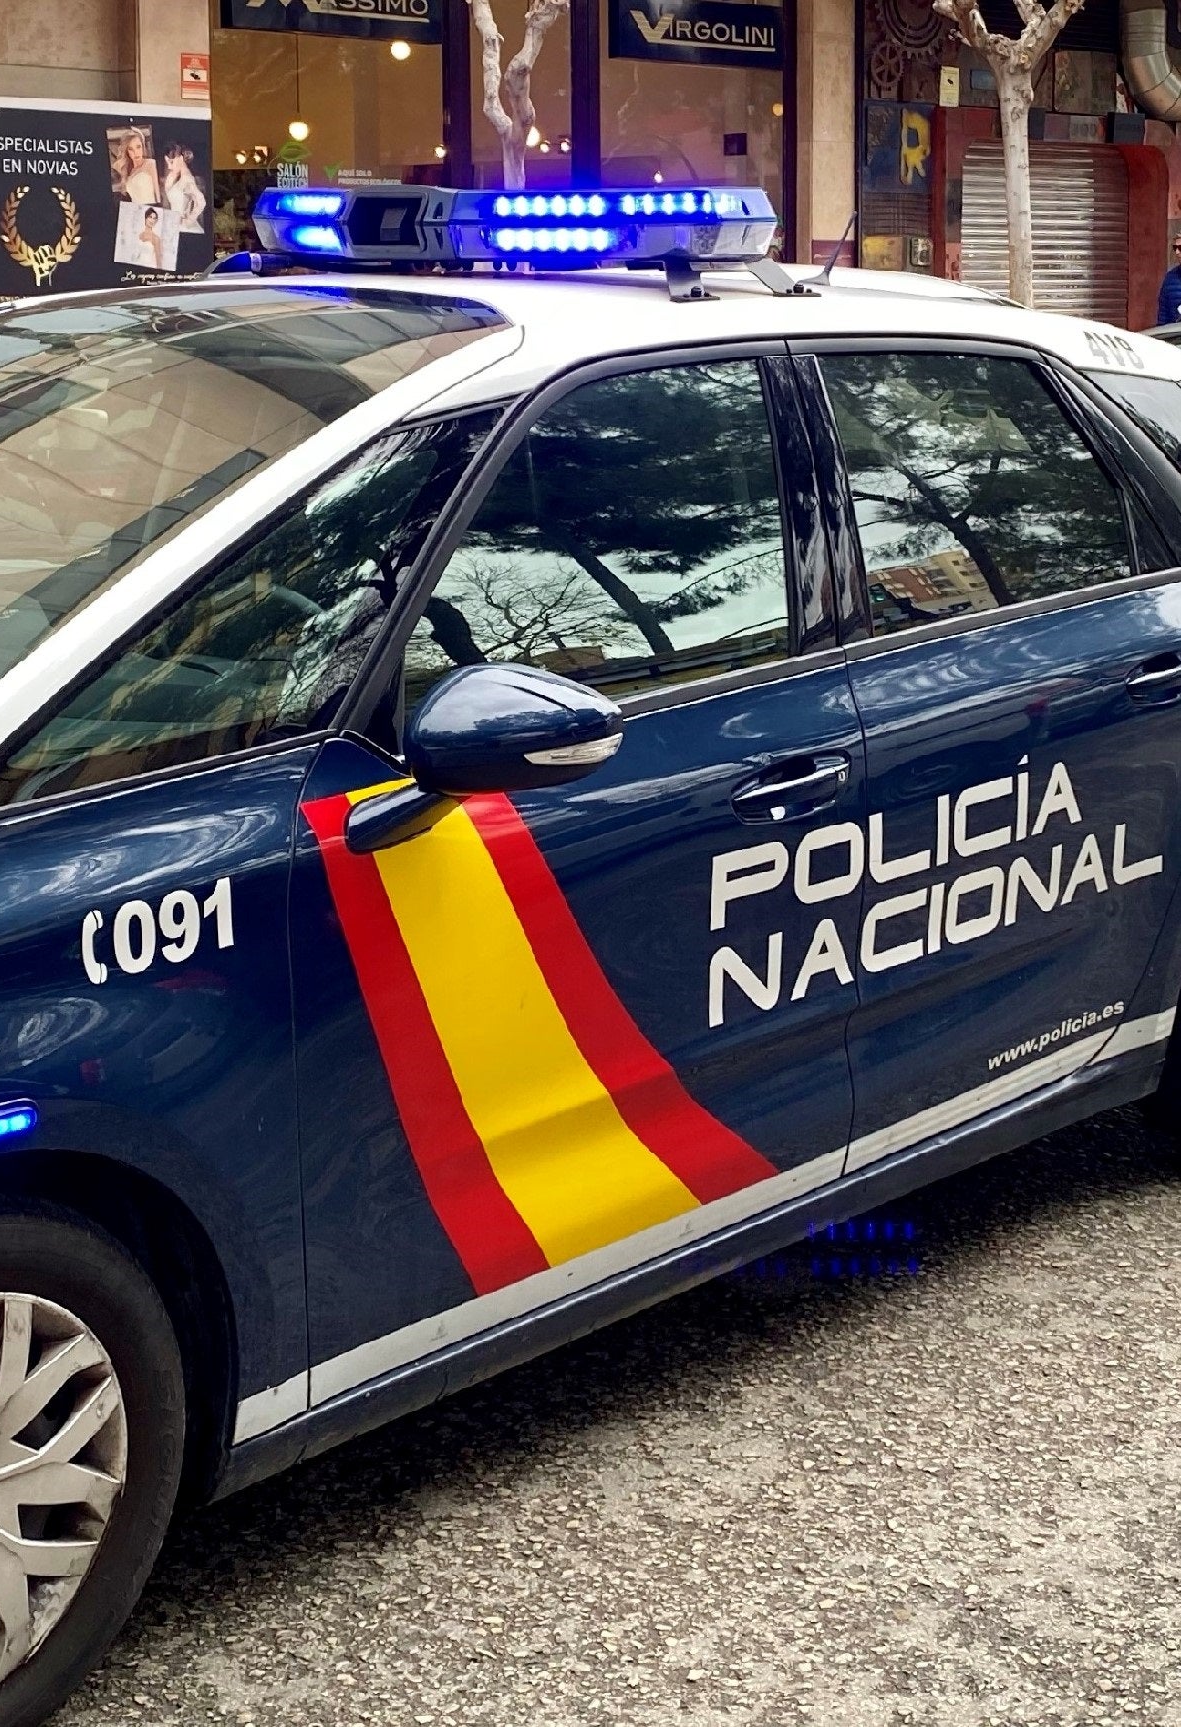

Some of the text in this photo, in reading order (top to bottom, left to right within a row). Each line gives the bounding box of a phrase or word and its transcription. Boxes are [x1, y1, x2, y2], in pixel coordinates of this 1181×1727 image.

[630, 9, 775, 47] VIRGOLINI
[2, 158, 79, 176] EN NOVIAS
[276, 161, 309, 178] SALÓN
[710, 754, 1082, 931] POLICÍA
[113, 876, 235, 974] 091
[709, 823, 1163, 1028] NACIONAL
[988, 1001, 1125, 1070] www.policia.es
